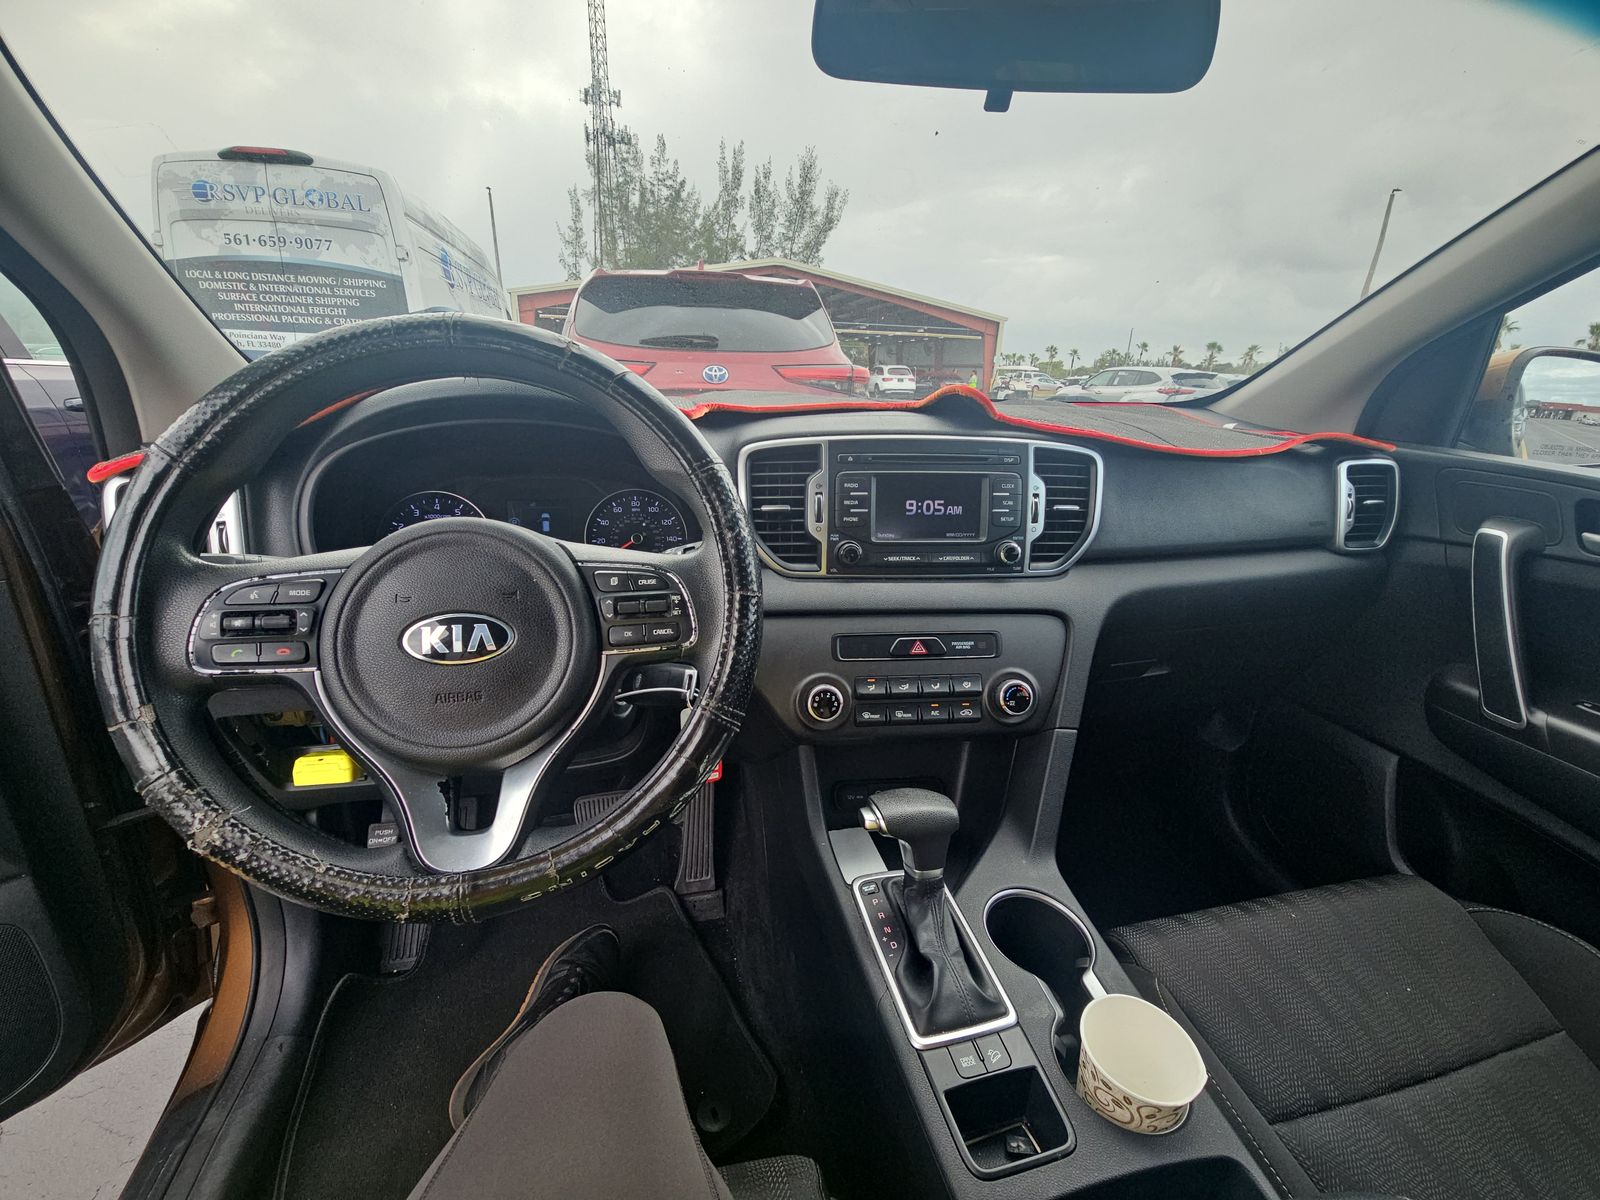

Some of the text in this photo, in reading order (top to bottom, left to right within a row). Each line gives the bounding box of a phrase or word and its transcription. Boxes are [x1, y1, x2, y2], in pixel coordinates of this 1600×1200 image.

[207, 182, 371, 213] RSVP GLOBAL
[185, 269, 213, 279] LOCAL
[214, 270, 221, 279] &
[223, 271, 249, 280] LONG
[251, 272, 296, 283] DISTANCE
[297, 275, 336, 285] MOVING
[343, 277, 387, 289] SHIPPING
[199, 280, 376, 298] DOMESTIC & INTERNATIONAL SERVICES
[218, 292, 360, 307] SURFACE CONTAINER SHIPPING
[234, 303, 347, 316] INTERNATIONAL FREIGHT
[211, 312, 280, 323] PROFESSIONAL
[281, 315, 323, 325] PACKING
[325, 317, 332, 325] &
[229, 331, 287, 343] Poinciana Way
[247, 340, 256, 348] FL
[257, 341, 282, 349] 33480
[455, 508, 461, 516] 5
[905, 500, 963, 516] 9:05 AM
[638, 578, 657, 586] CRUISE
[288, 589, 311, 597] MODE
[420, 623, 497, 655] KIA
[435, 690, 483, 705] AIRBAG
[872, 898, 879, 906] P
[884, 926, 892, 934] N
[890, 941, 898, 949] D
